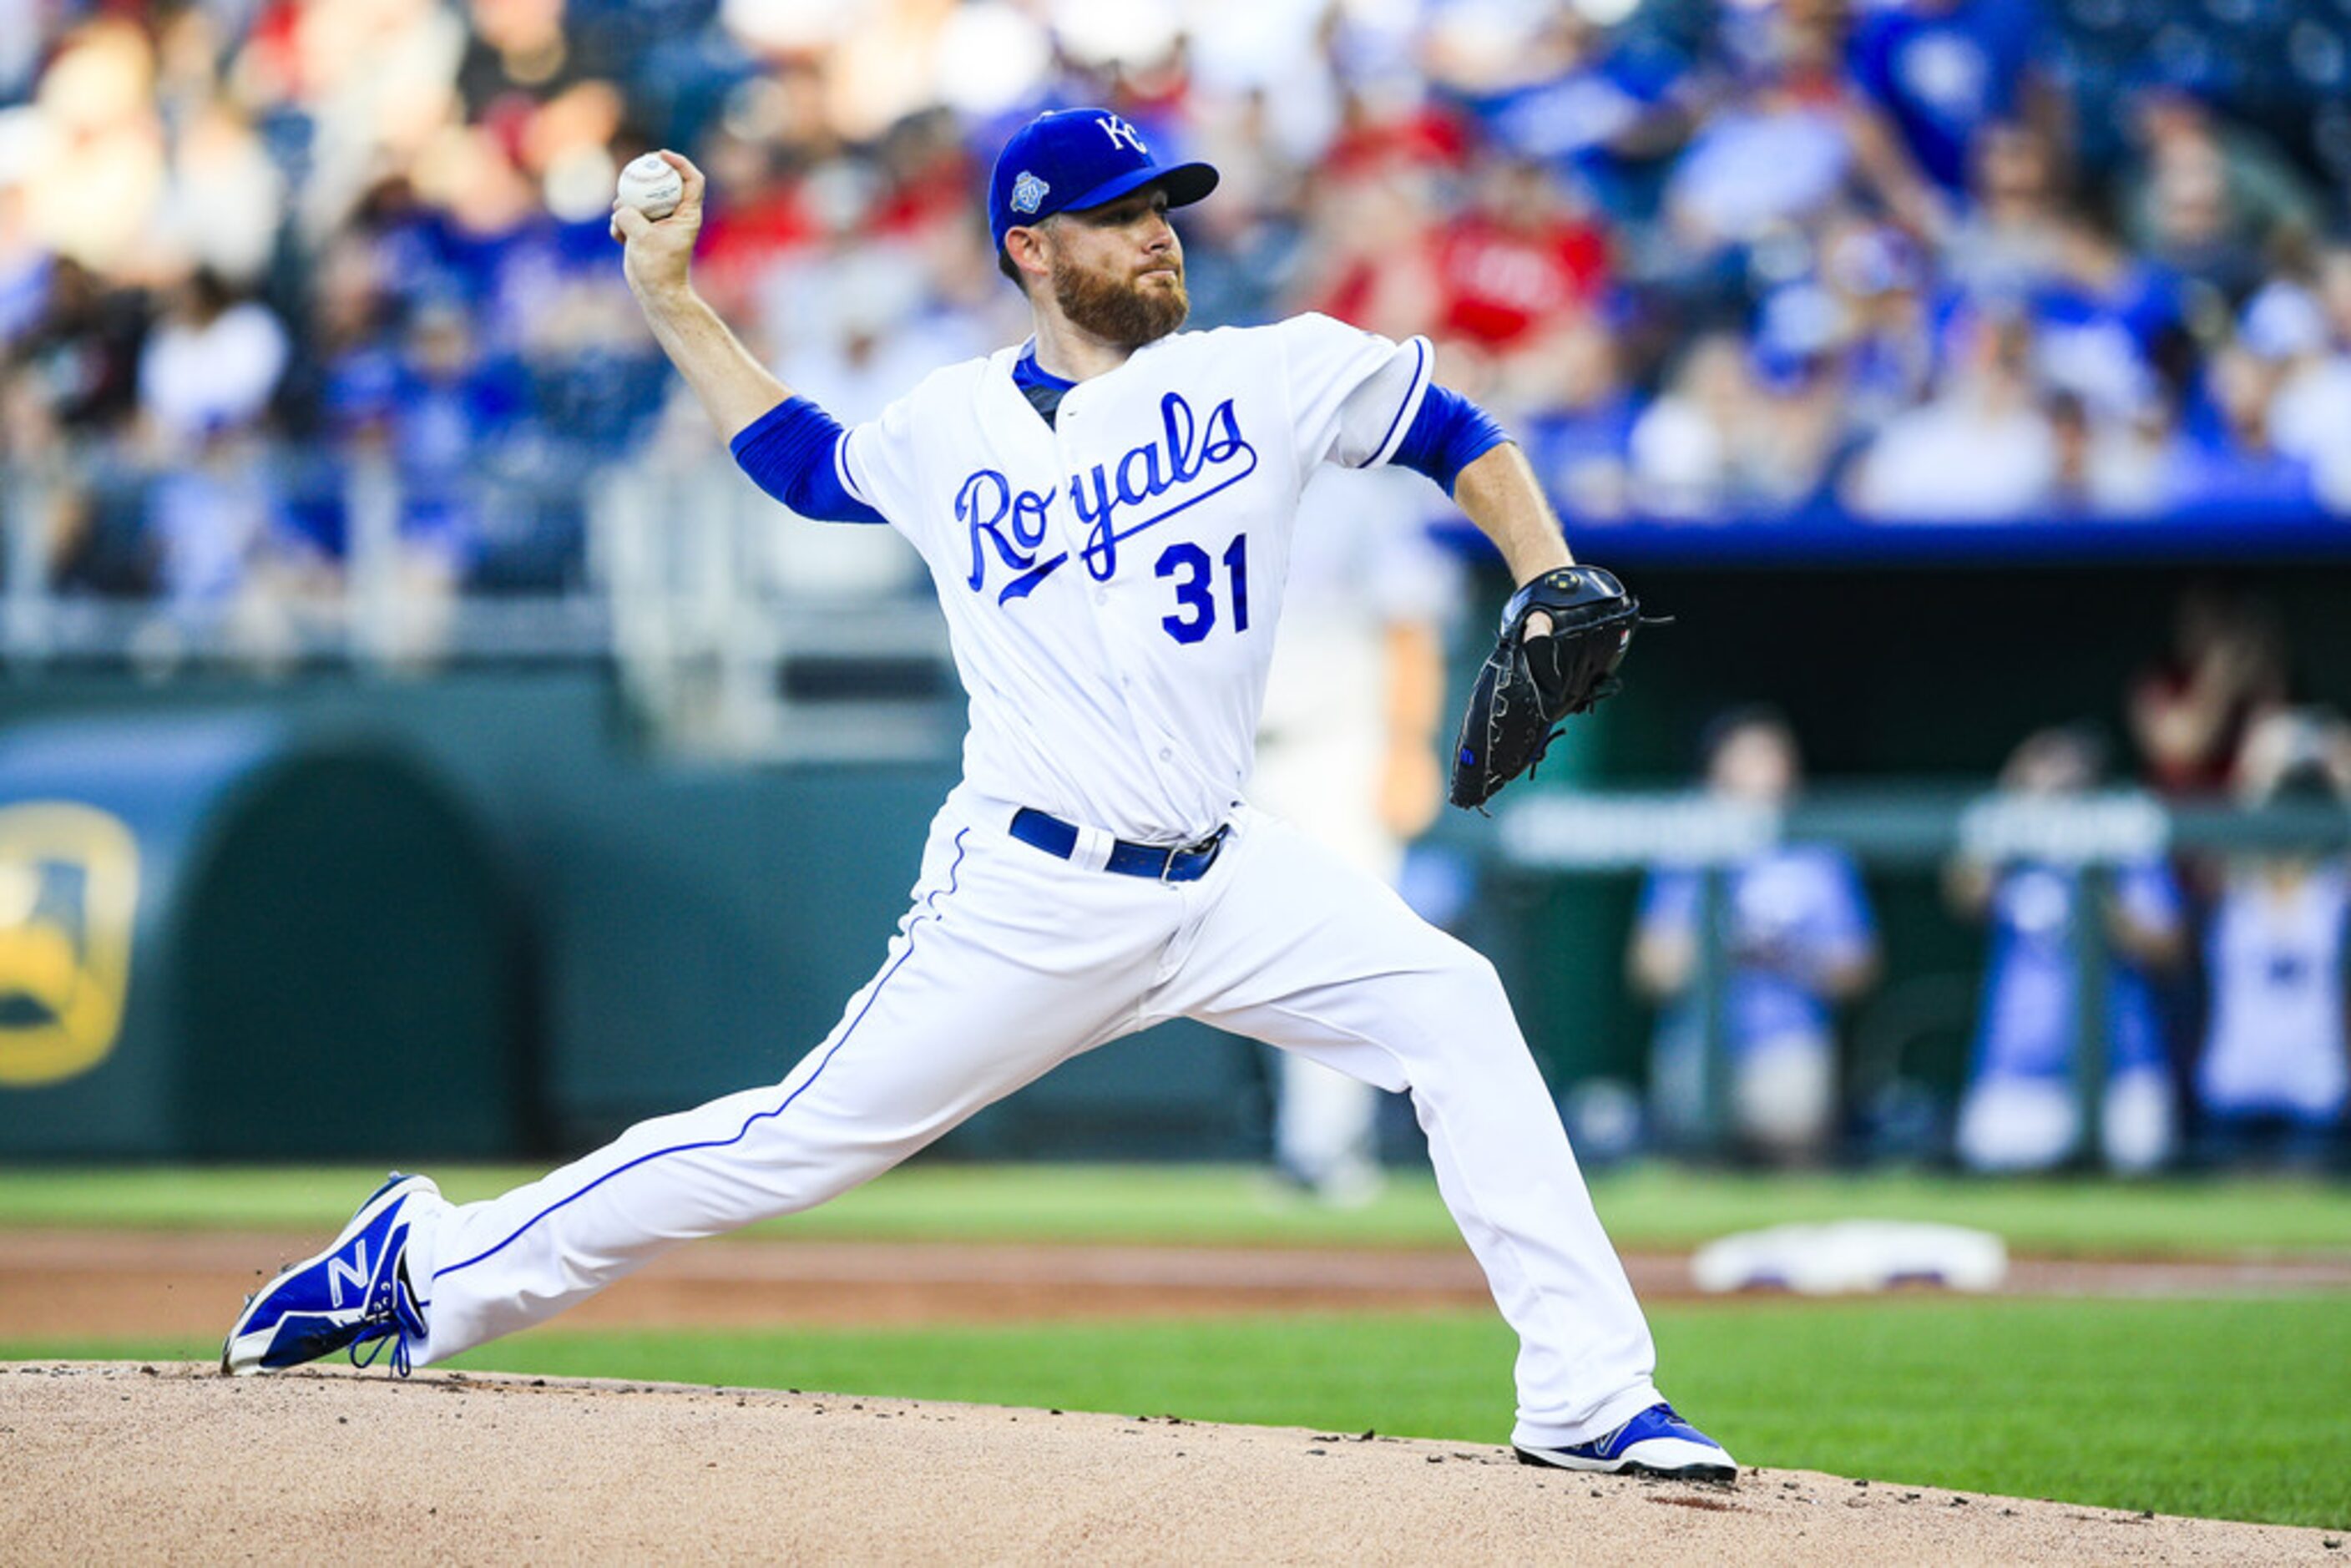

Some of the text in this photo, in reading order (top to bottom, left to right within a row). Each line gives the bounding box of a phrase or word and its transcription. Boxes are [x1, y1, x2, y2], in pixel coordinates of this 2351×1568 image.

[1095, 115, 1147, 154] KC
[955, 392, 1257, 594] Royals
[1155, 533, 1248, 645] 31
[328, 1239, 368, 1308] N
